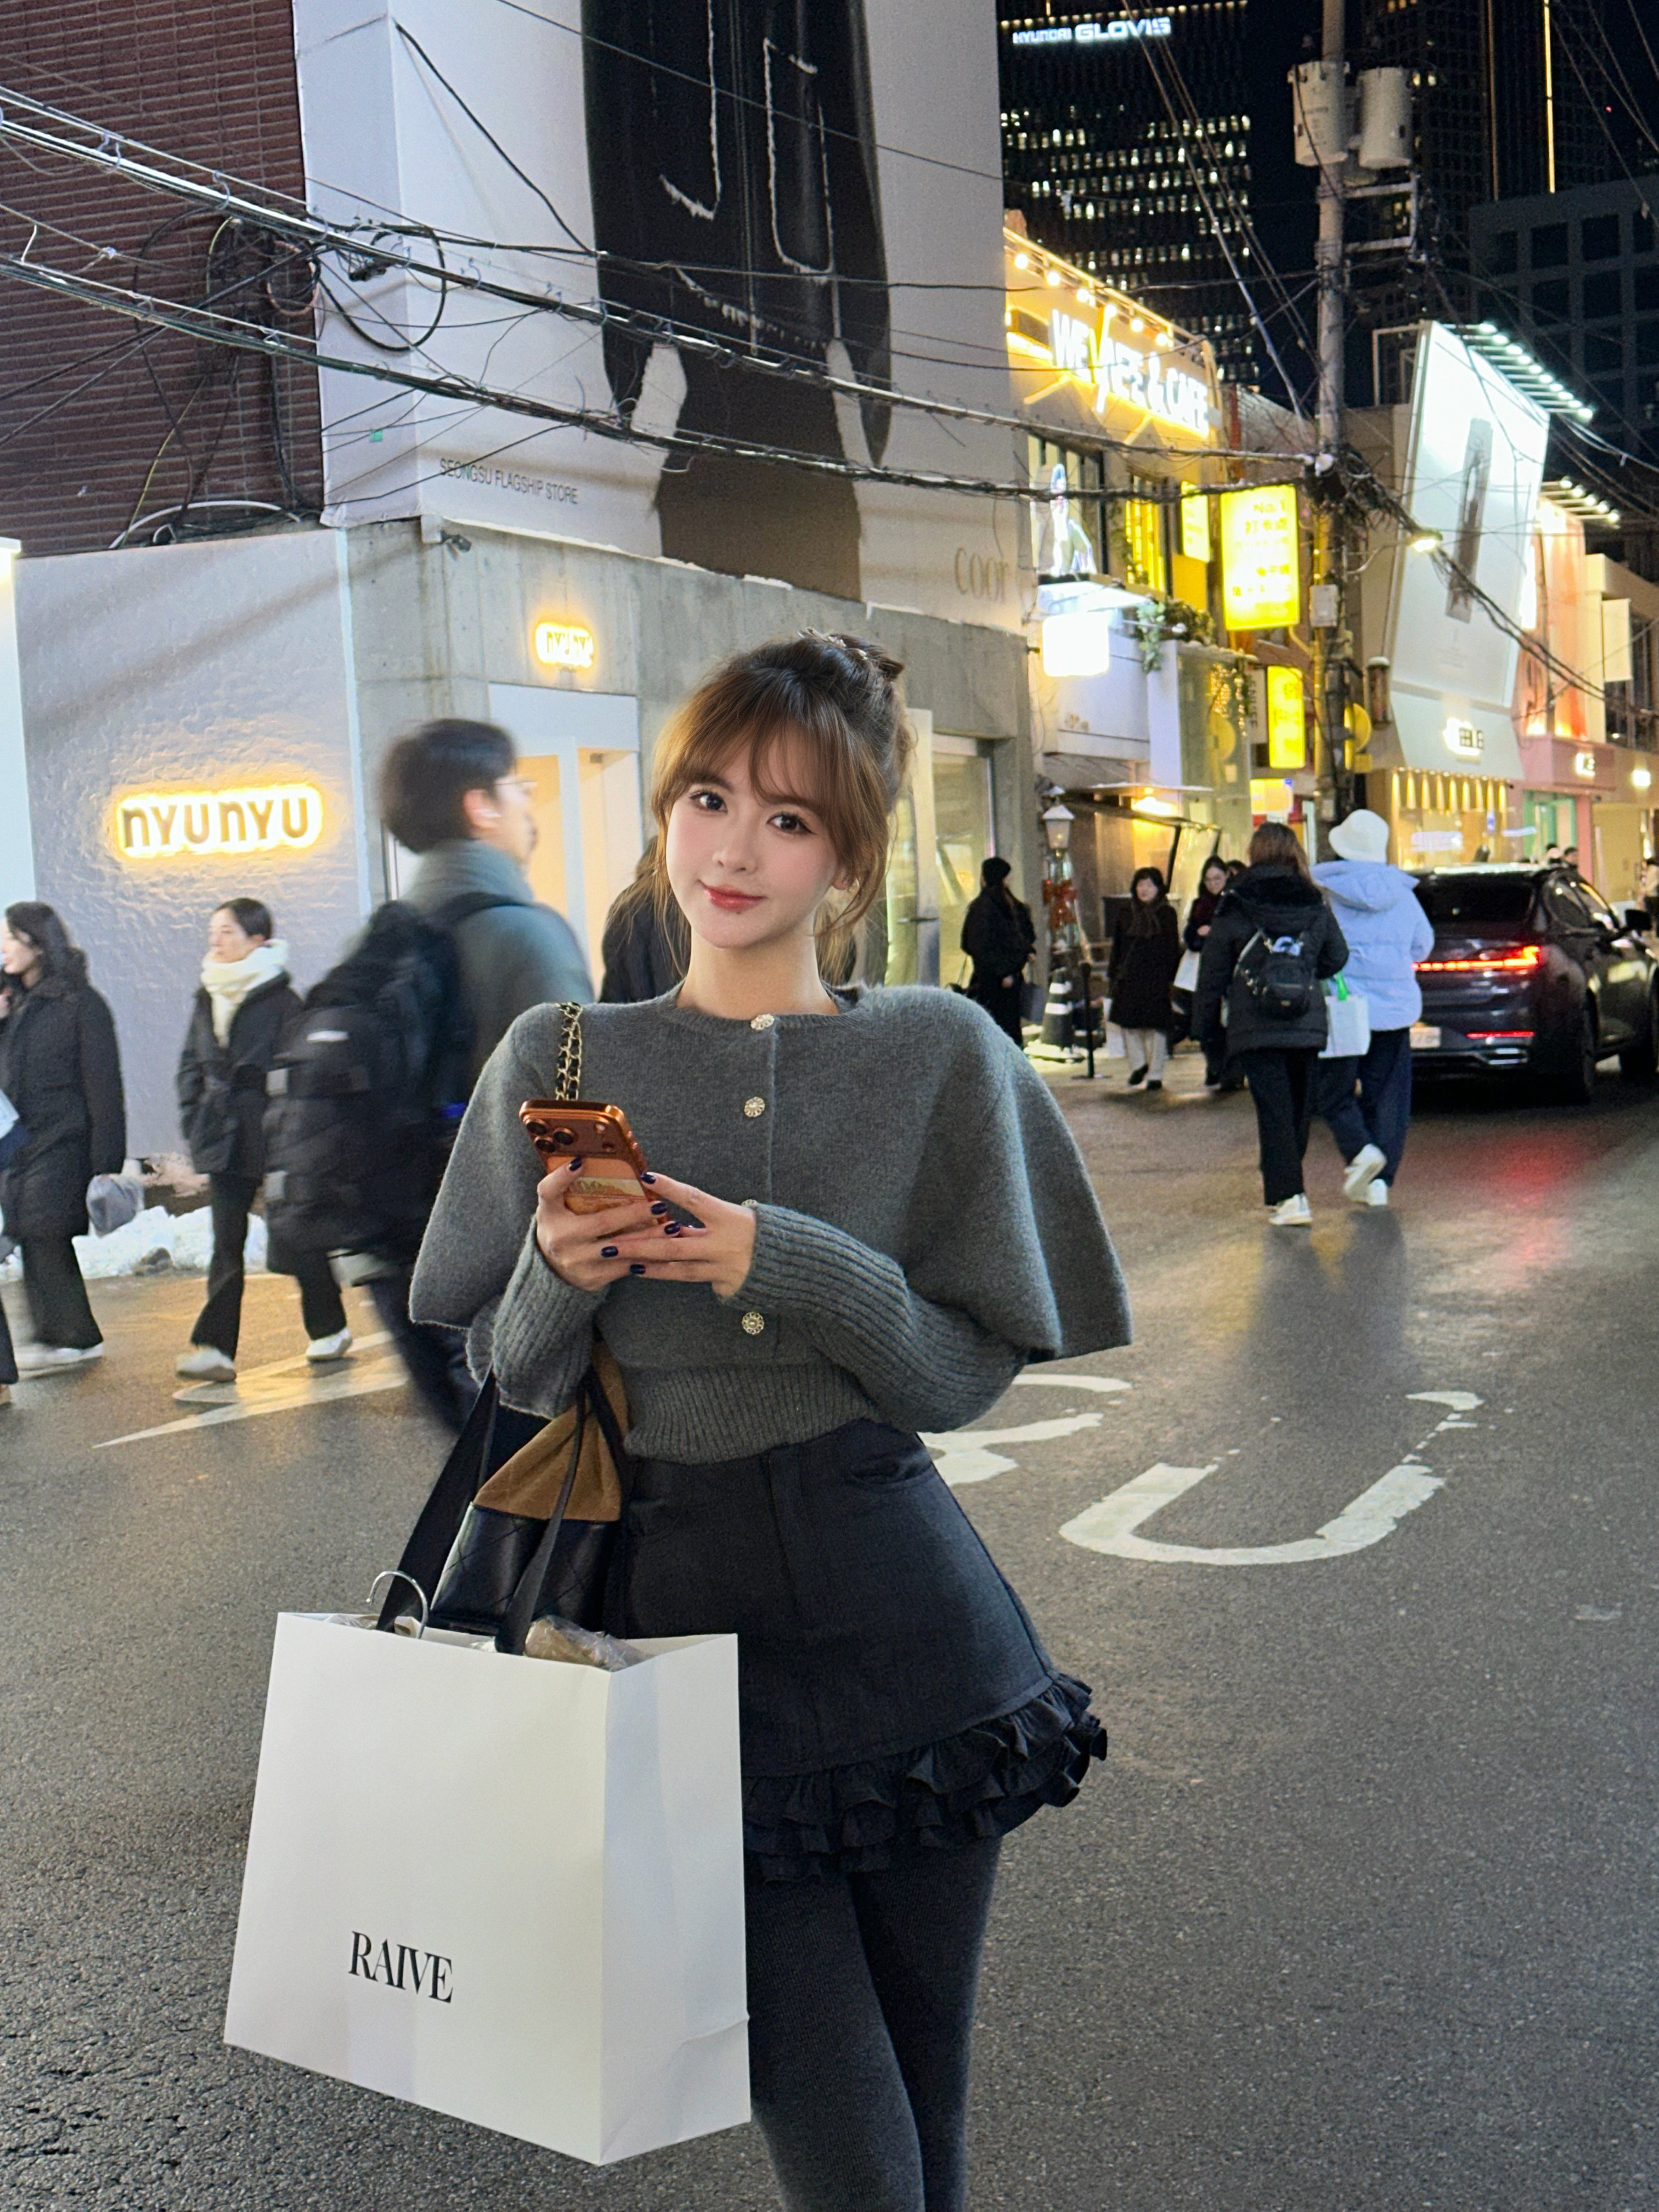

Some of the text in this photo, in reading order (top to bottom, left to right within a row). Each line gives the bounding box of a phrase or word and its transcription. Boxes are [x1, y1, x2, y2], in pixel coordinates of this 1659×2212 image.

[1075, 16, 1172, 43] GLOVIS
[439, 458, 579, 504] SEONGSU FLAGSHIP STORE
[348, 1930, 454, 2004] RAIVE
